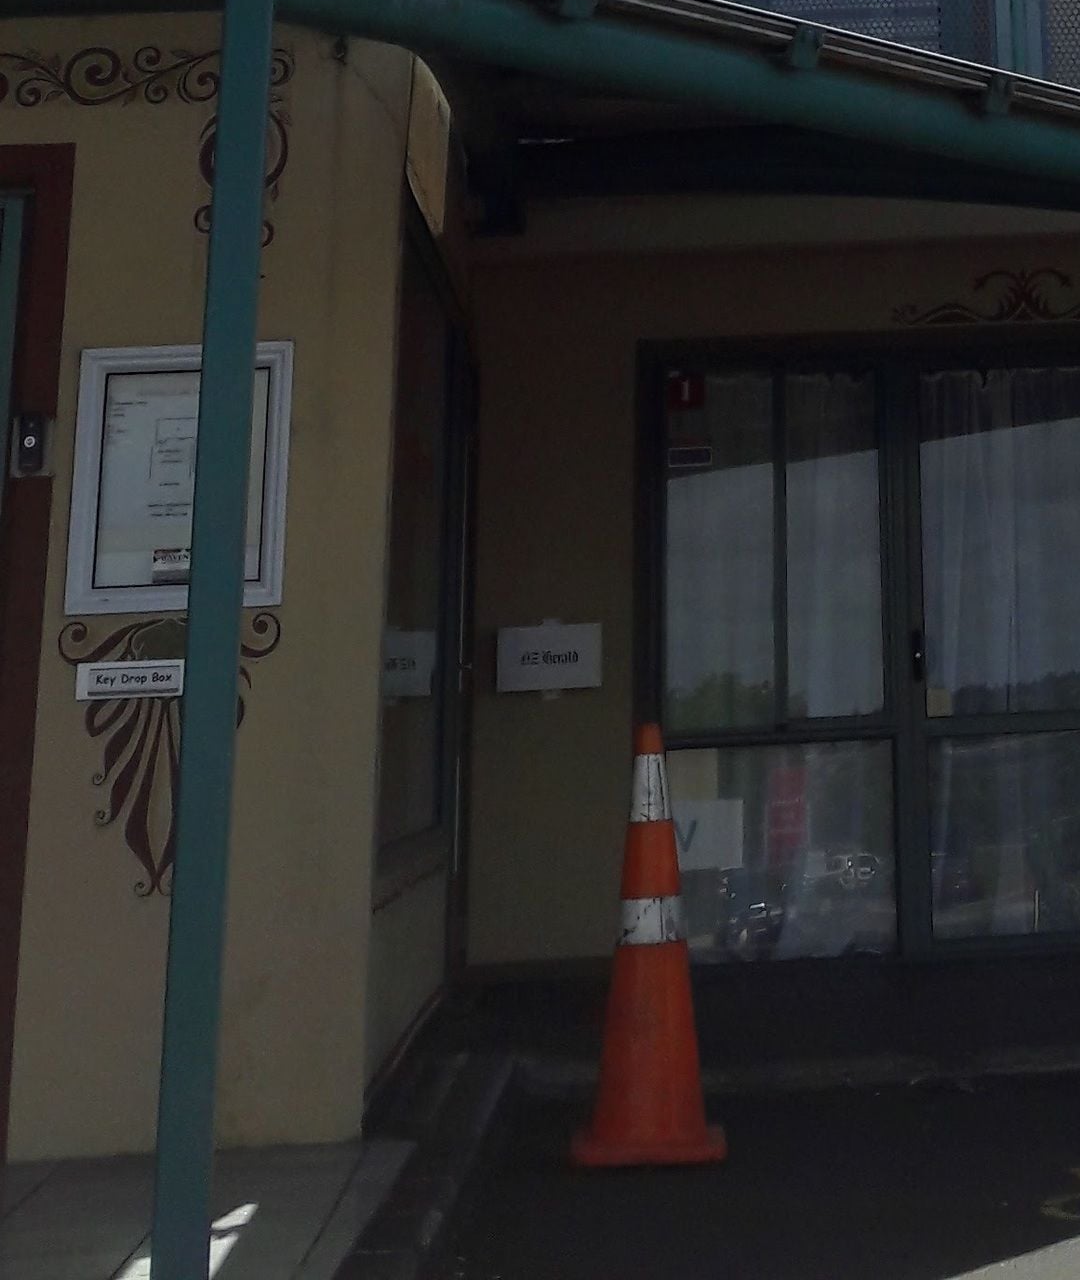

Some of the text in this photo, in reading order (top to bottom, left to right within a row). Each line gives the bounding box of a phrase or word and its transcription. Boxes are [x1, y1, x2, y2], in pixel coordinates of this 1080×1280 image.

[680, 378, 690, 402] 1
[542, 650, 579, 665] Herald
[95, 671, 172, 687] Key Drop Box
